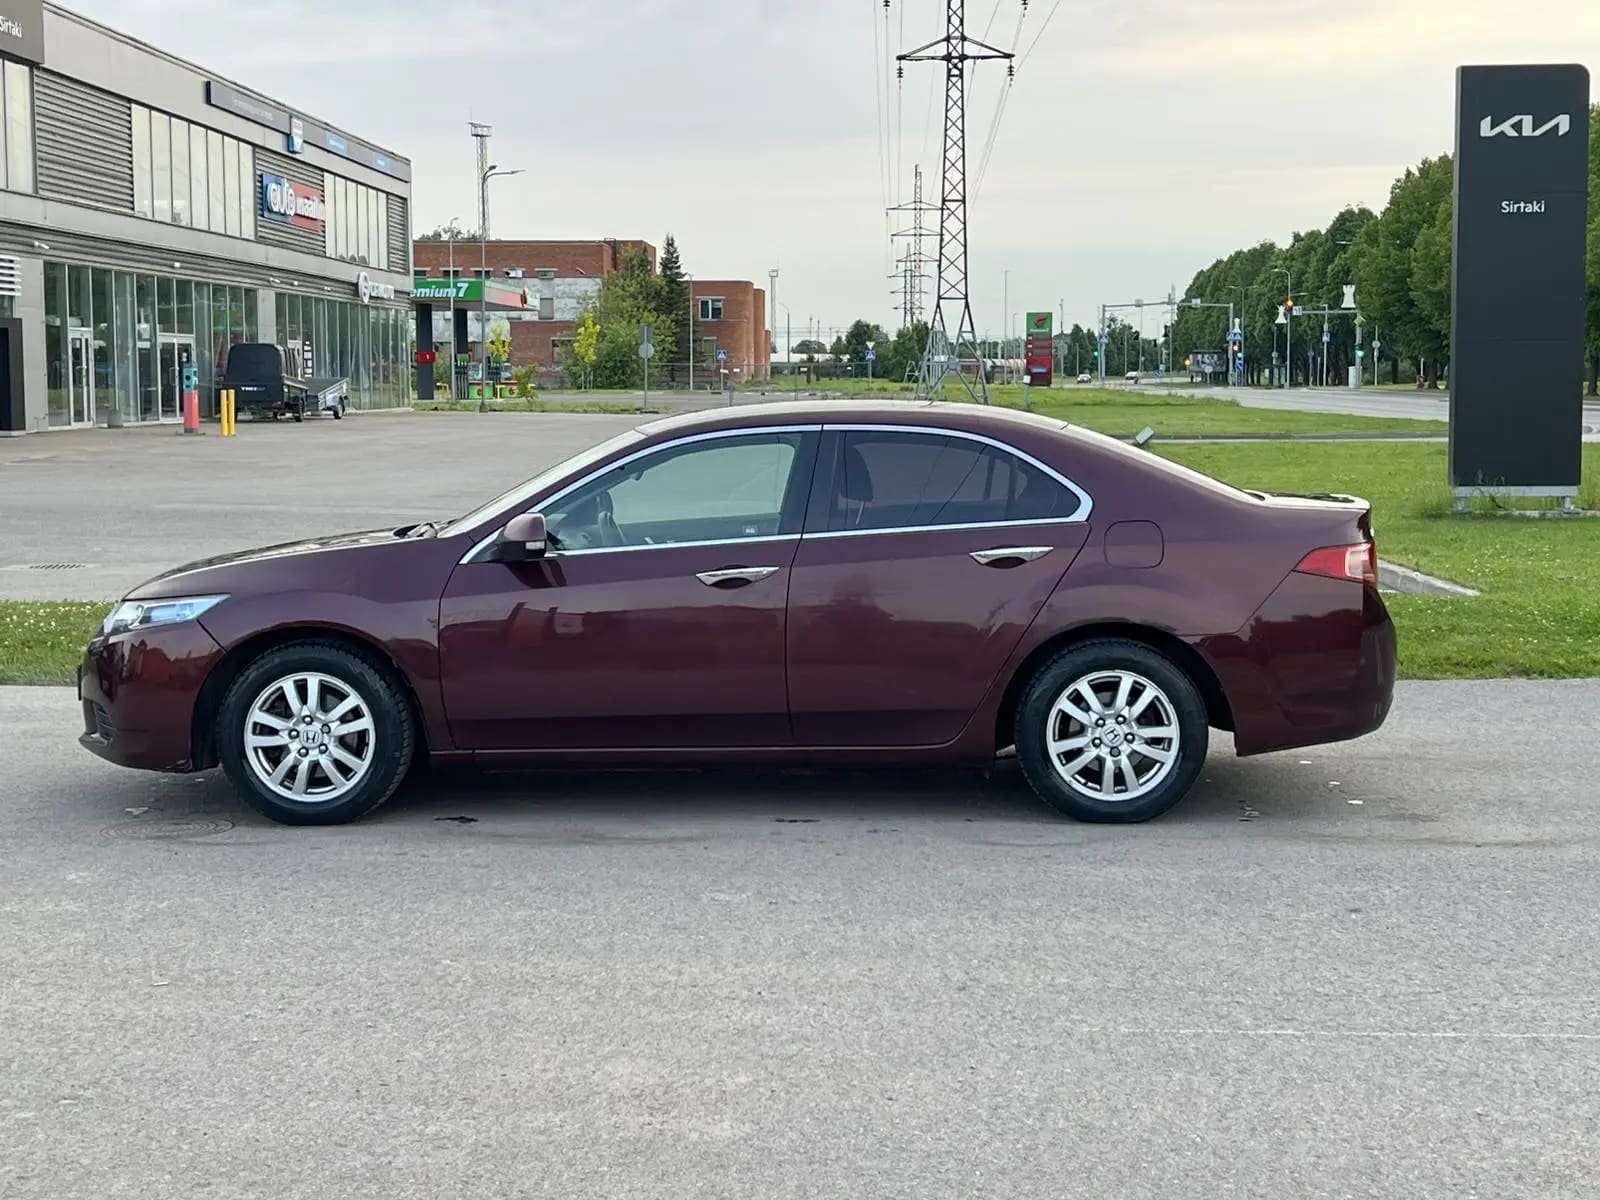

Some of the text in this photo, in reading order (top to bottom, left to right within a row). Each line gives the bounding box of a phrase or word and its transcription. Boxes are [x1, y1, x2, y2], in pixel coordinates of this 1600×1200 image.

[0, 16, 22, 38] Sirtaki
[1480, 114, 1570, 137] KIA
[1501, 200, 1545, 213] Sirtaki
